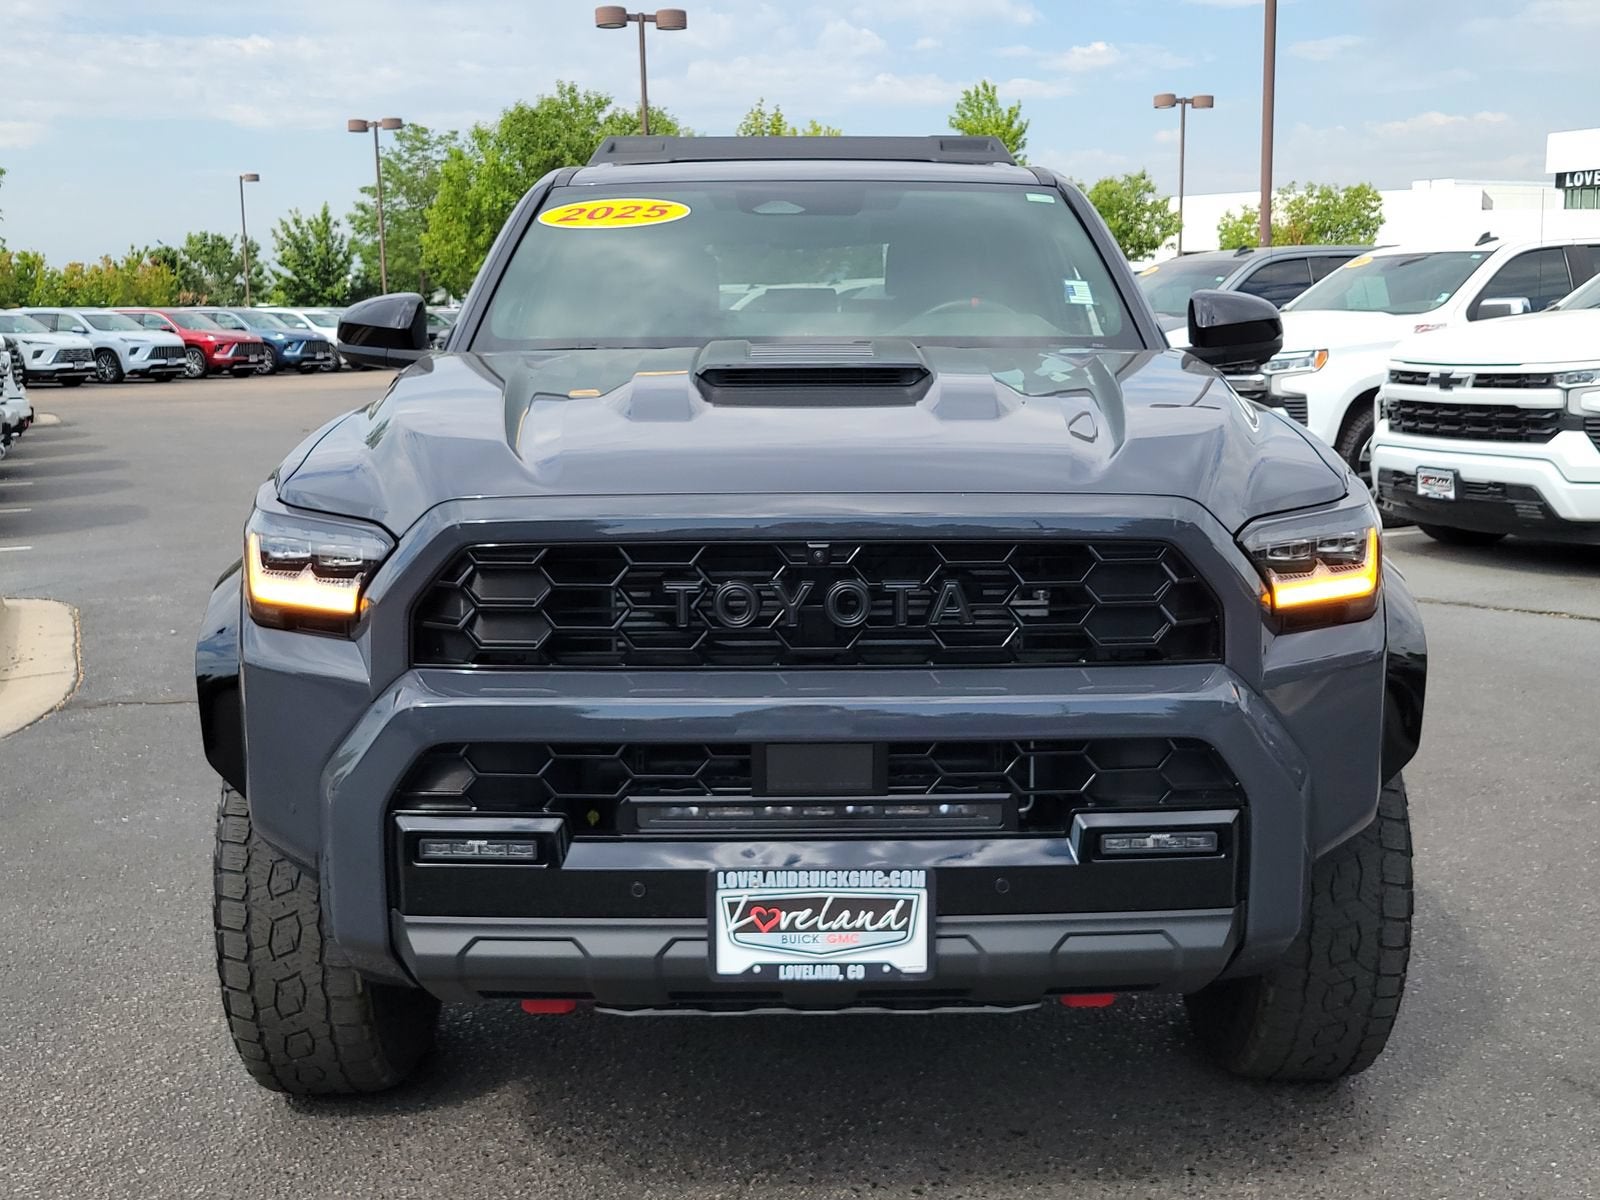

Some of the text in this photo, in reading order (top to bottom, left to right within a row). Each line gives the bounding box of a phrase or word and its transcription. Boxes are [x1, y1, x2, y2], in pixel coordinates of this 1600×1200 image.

[556, 204, 673, 222] 2025
[662, 579, 976, 628] TOYOTA
[781, 932, 860, 945] BUICK GMC
[778, 964, 865, 981] LOVELAND, CO
